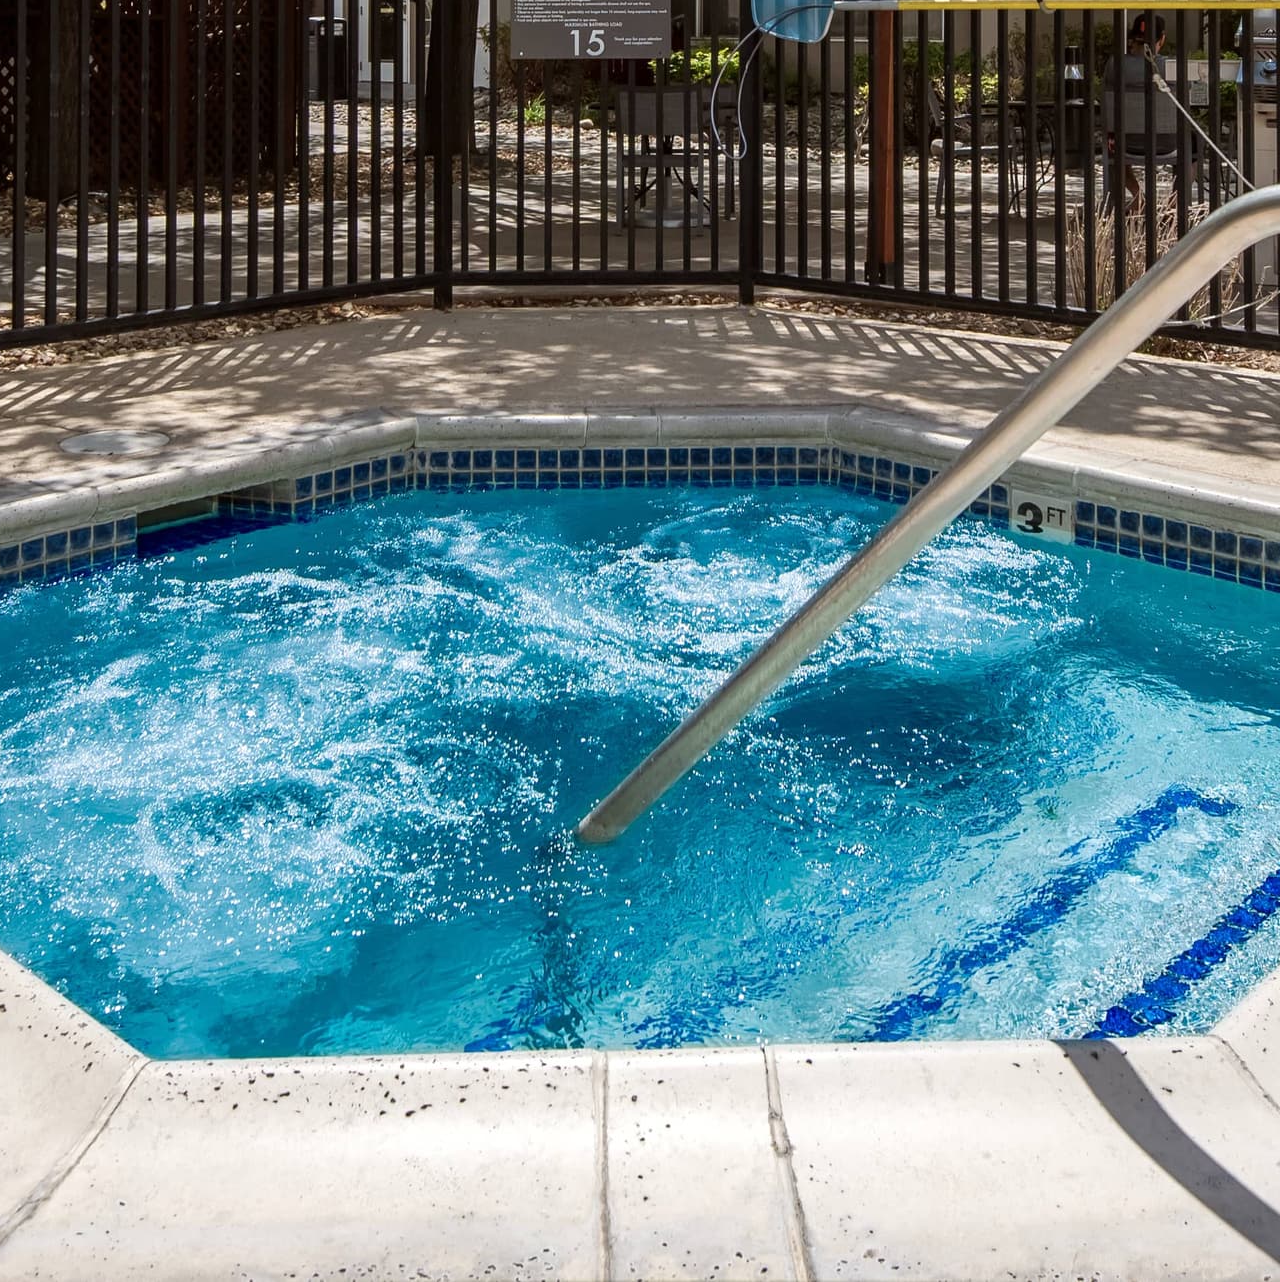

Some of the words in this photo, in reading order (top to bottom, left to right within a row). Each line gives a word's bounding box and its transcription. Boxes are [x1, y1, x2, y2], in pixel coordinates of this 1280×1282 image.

[570, 29, 605, 56] 15
[1017, 501, 1044, 533] 3
[1047, 506, 1067, 526] FT
